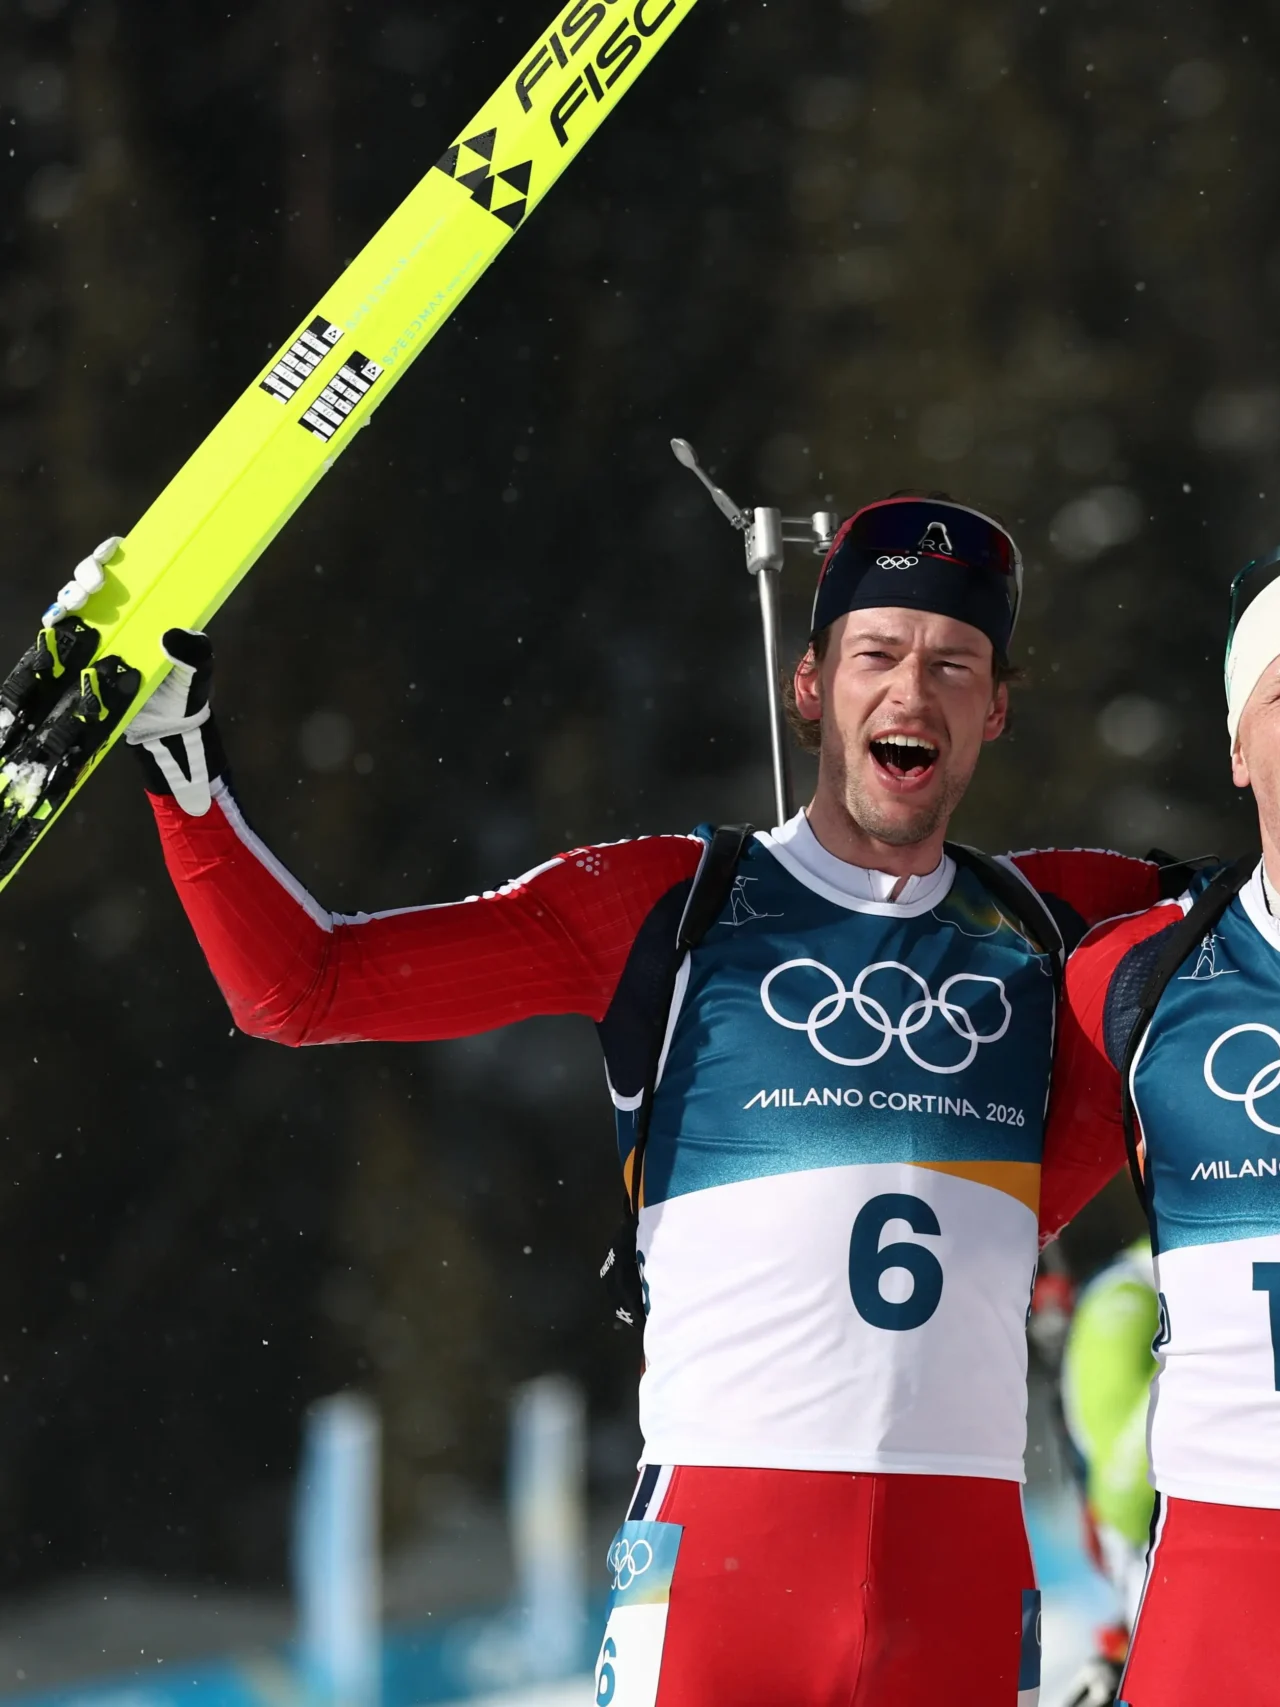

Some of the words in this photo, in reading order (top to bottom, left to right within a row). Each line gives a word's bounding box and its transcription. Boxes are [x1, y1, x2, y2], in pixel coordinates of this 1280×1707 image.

[515, 0, 618, 114] FIS
[743, 1087, 863, 1110] MILANO
[868, 1090, 981, 1119] CORTINA
[986, 1102, 1025, 1127] 2026
[848, 1192, 944, 1332] 6
